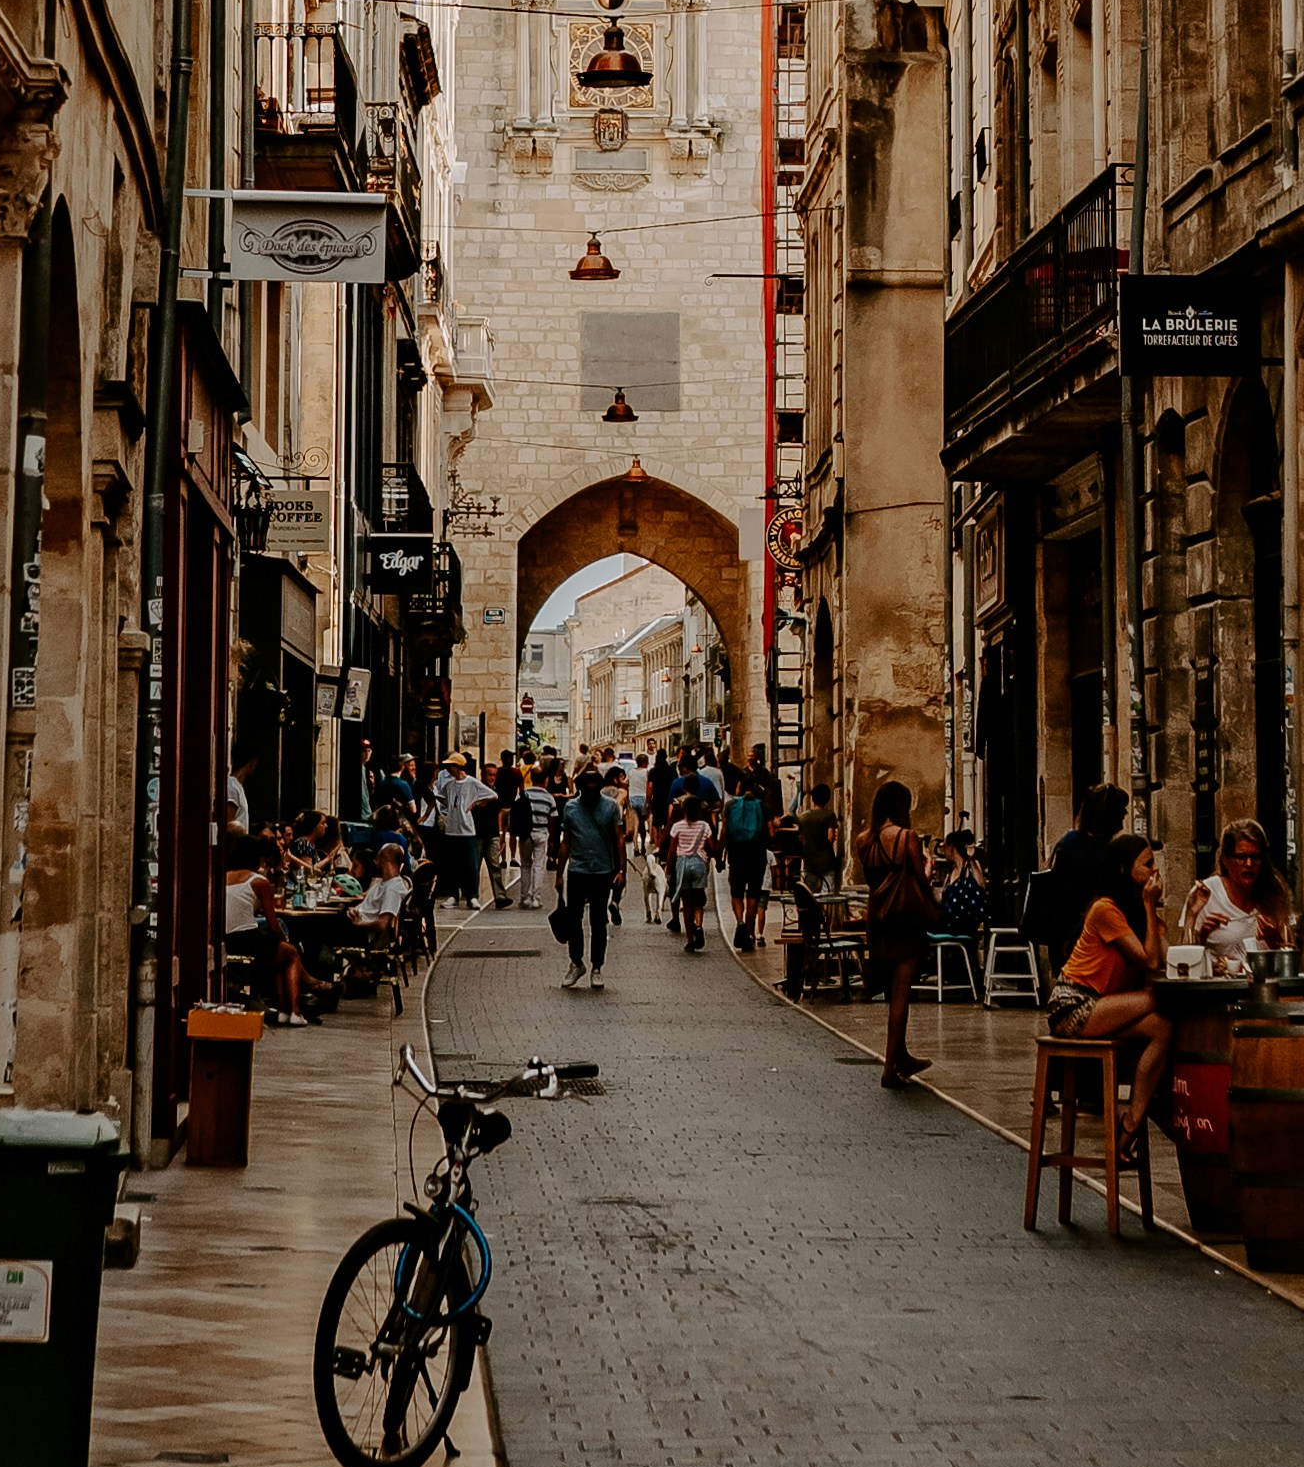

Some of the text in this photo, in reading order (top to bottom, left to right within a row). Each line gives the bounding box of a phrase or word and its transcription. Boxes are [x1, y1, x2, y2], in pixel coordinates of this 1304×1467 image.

[263, 238, 355, 257] Dock des épices
[1142, 317, 1162, 331] LA
[1203, 334, 1213, 346] DE
[769, 509, 802, 536] VINTAG
[379, 548, 425, 577] Edgar
